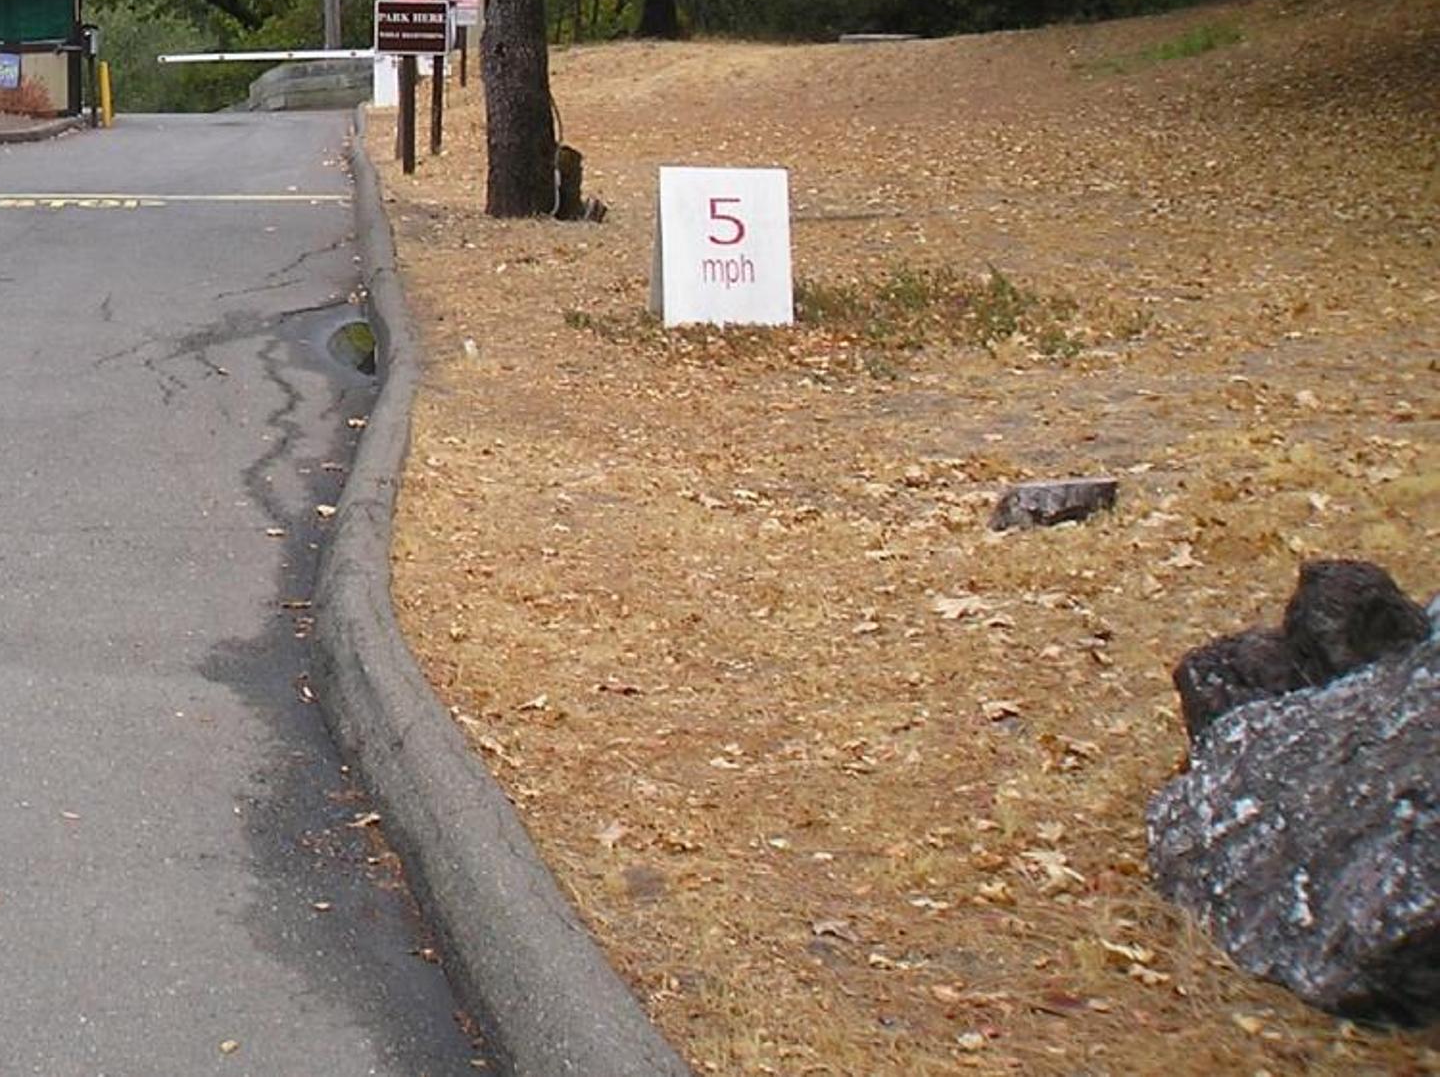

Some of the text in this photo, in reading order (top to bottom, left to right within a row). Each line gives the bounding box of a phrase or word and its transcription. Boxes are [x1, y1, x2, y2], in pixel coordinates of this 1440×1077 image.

[378, 12, 444, 23] PARK HERE
[708, 197, 745, 245] 5
[702, 253, 755, 289] mph
